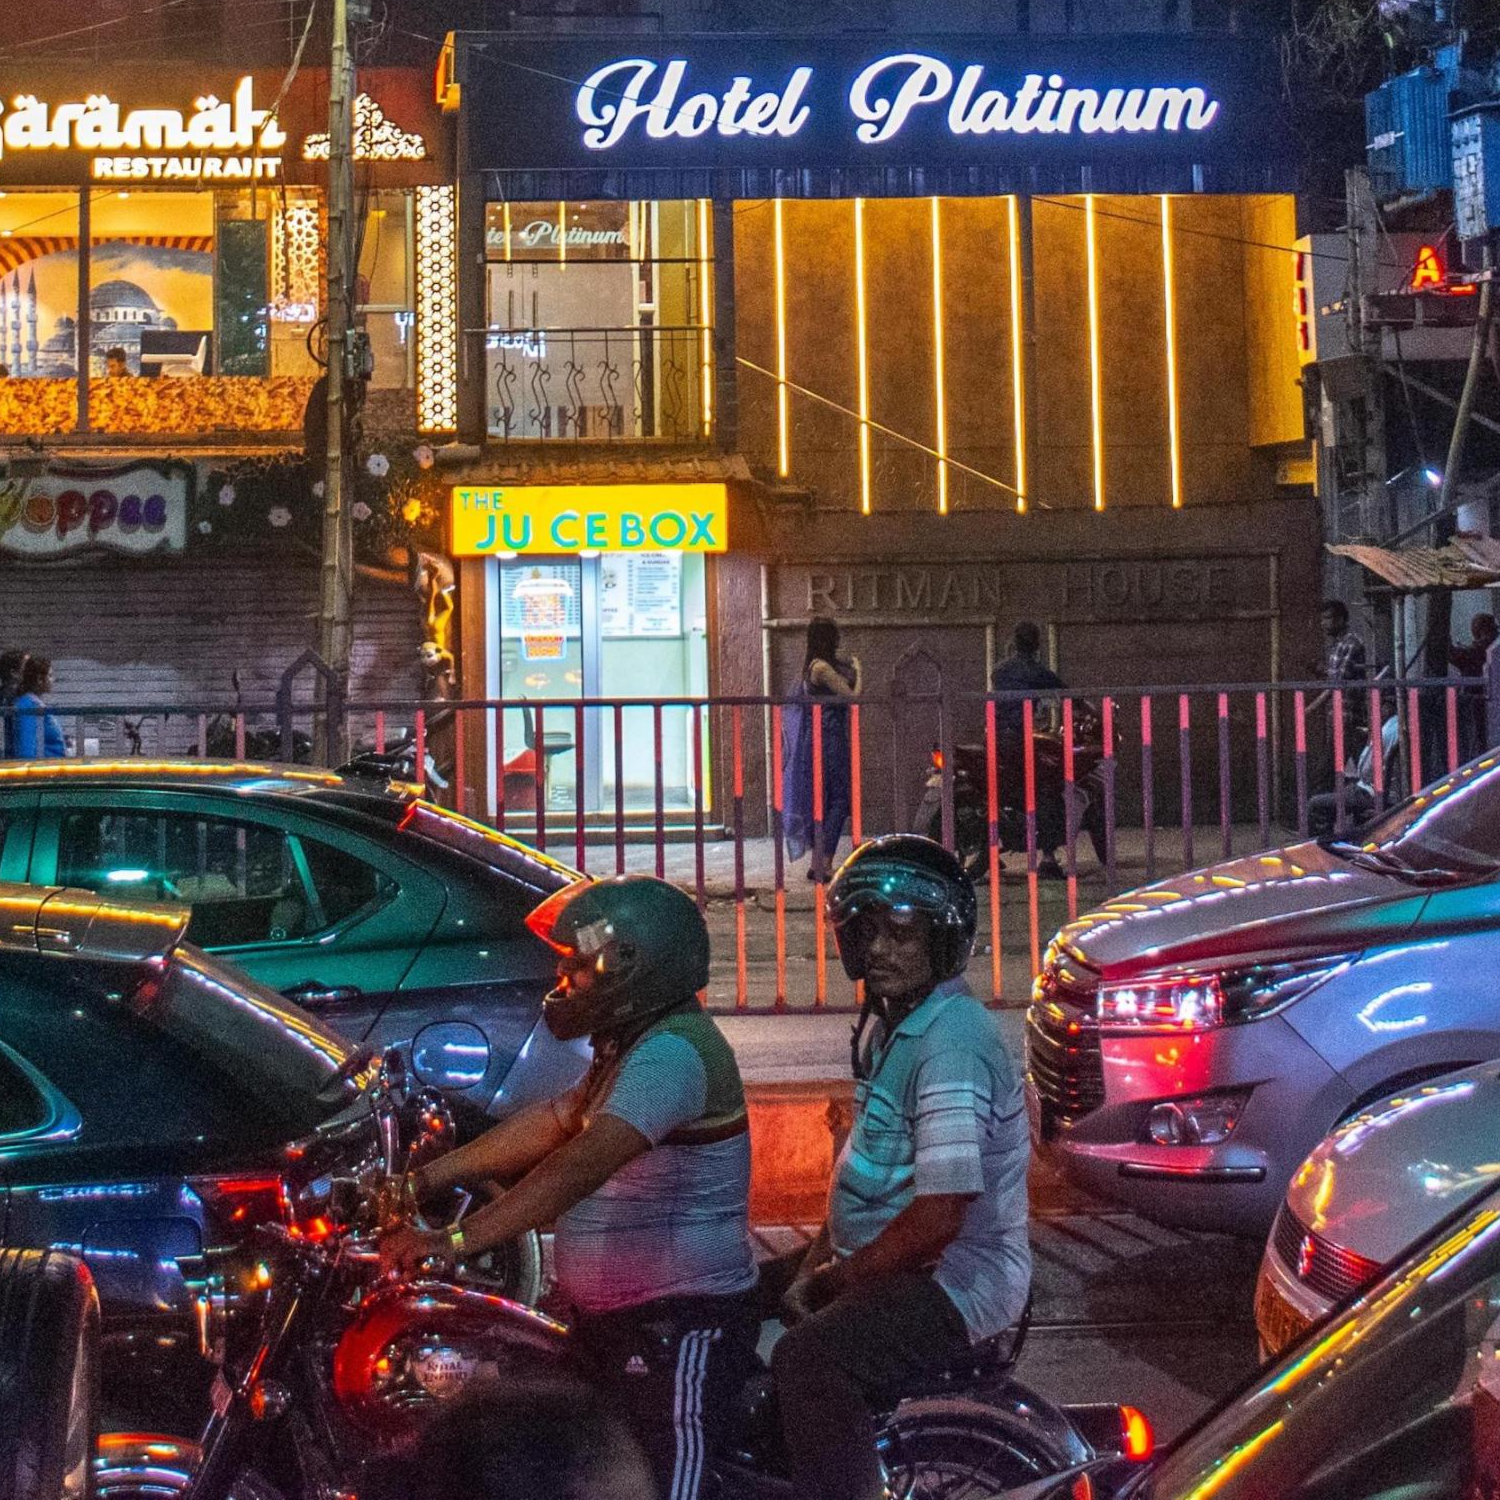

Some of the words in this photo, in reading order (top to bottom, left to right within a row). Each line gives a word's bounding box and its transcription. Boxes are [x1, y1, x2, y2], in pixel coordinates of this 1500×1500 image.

[575, 57, 813, 150] Hotel
[848, 52, 1220, 146] Platinum
[93, 156, 282, 179] RESTAURANT
[460, 492, 504, 510] THE
[620, 511, 716, 549] BOX
[803, 567, 1007, 612] RITMAN
[1060, 565, 1235, 610] HOUSE
